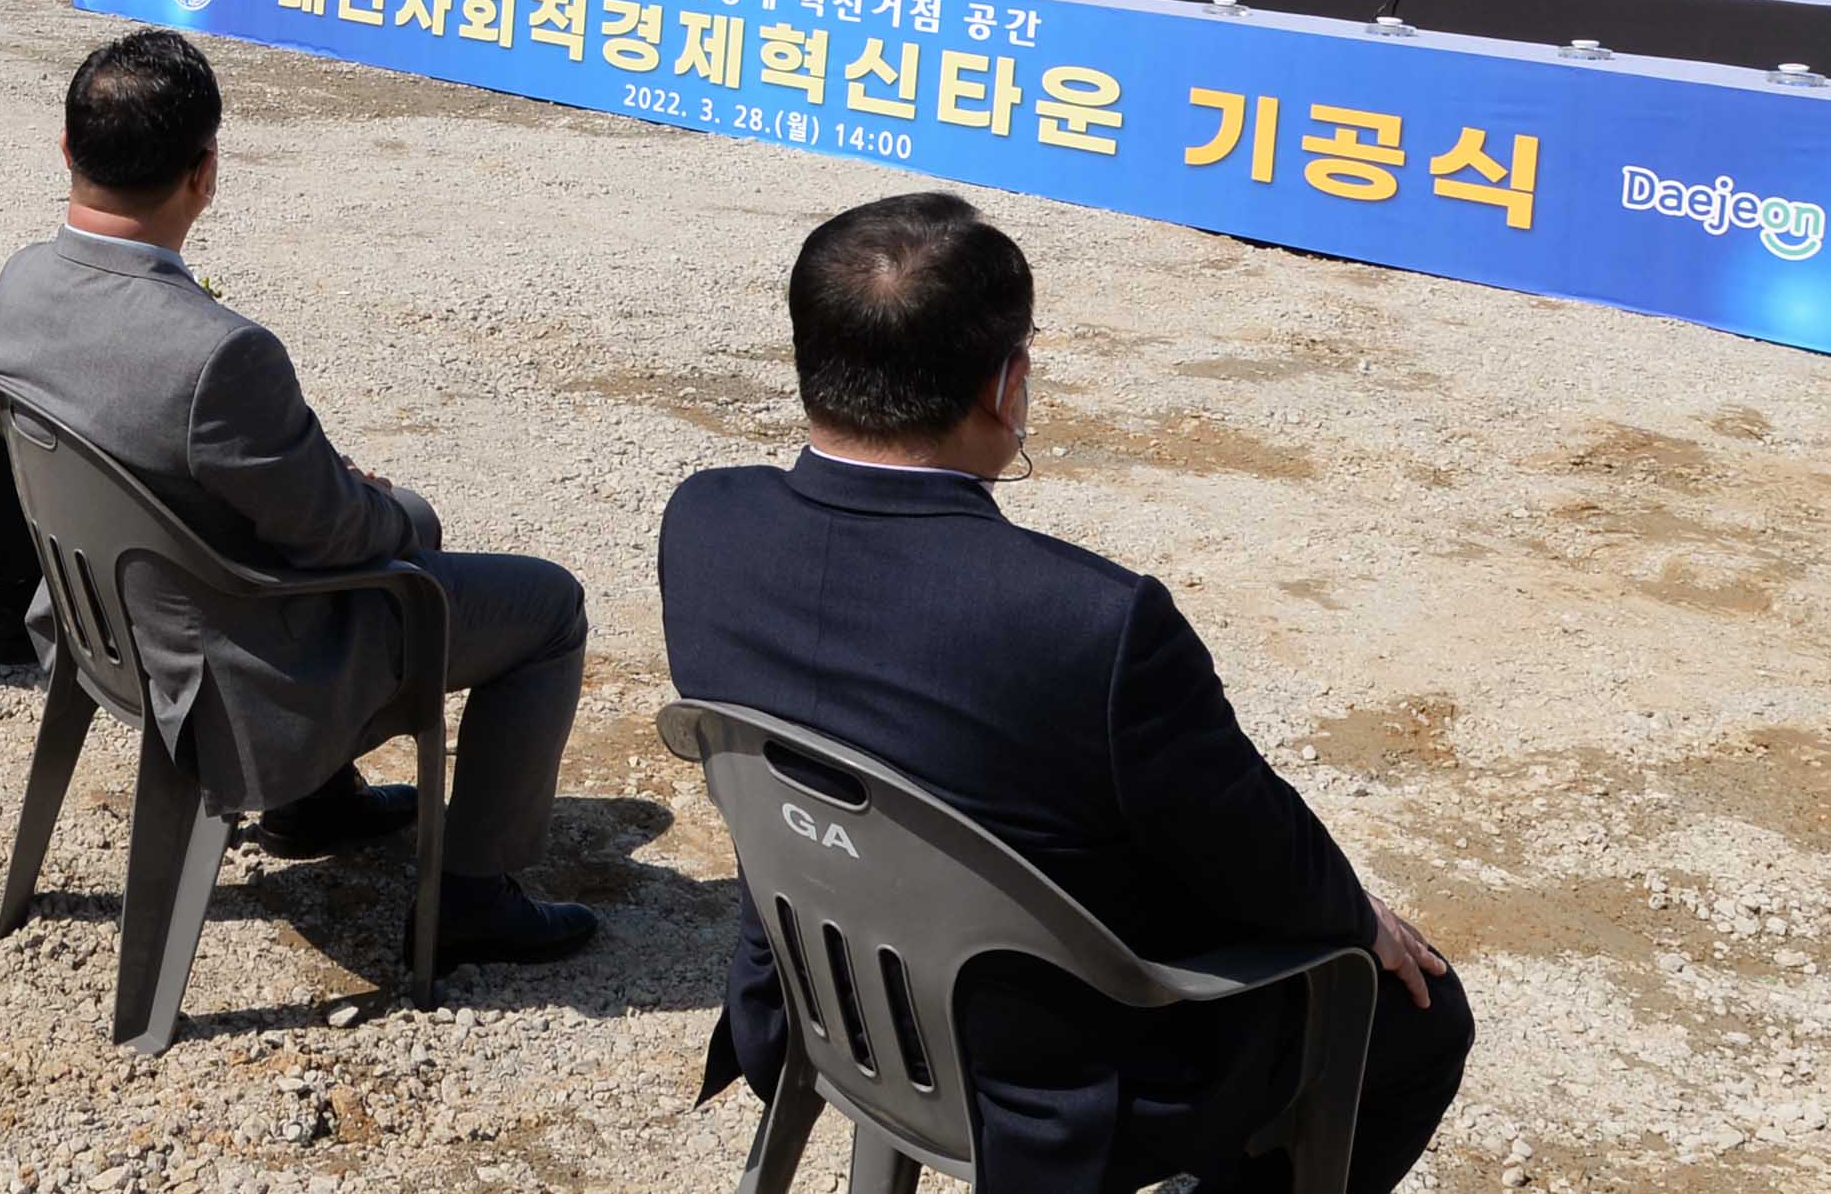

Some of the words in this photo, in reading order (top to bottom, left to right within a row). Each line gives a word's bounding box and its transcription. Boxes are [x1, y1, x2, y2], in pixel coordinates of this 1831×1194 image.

[963, 1, 1042, 48] 공간
[623, 84, 687, 117] 2022.
[700, 98, 720, 124] 3.
[835, 123, 913, 159] 14:00
[1183, 86, 1539, 231] 기공식
[1622, 165, 1826, 238] Daejeon
[781, 802, 861, 859] GA
